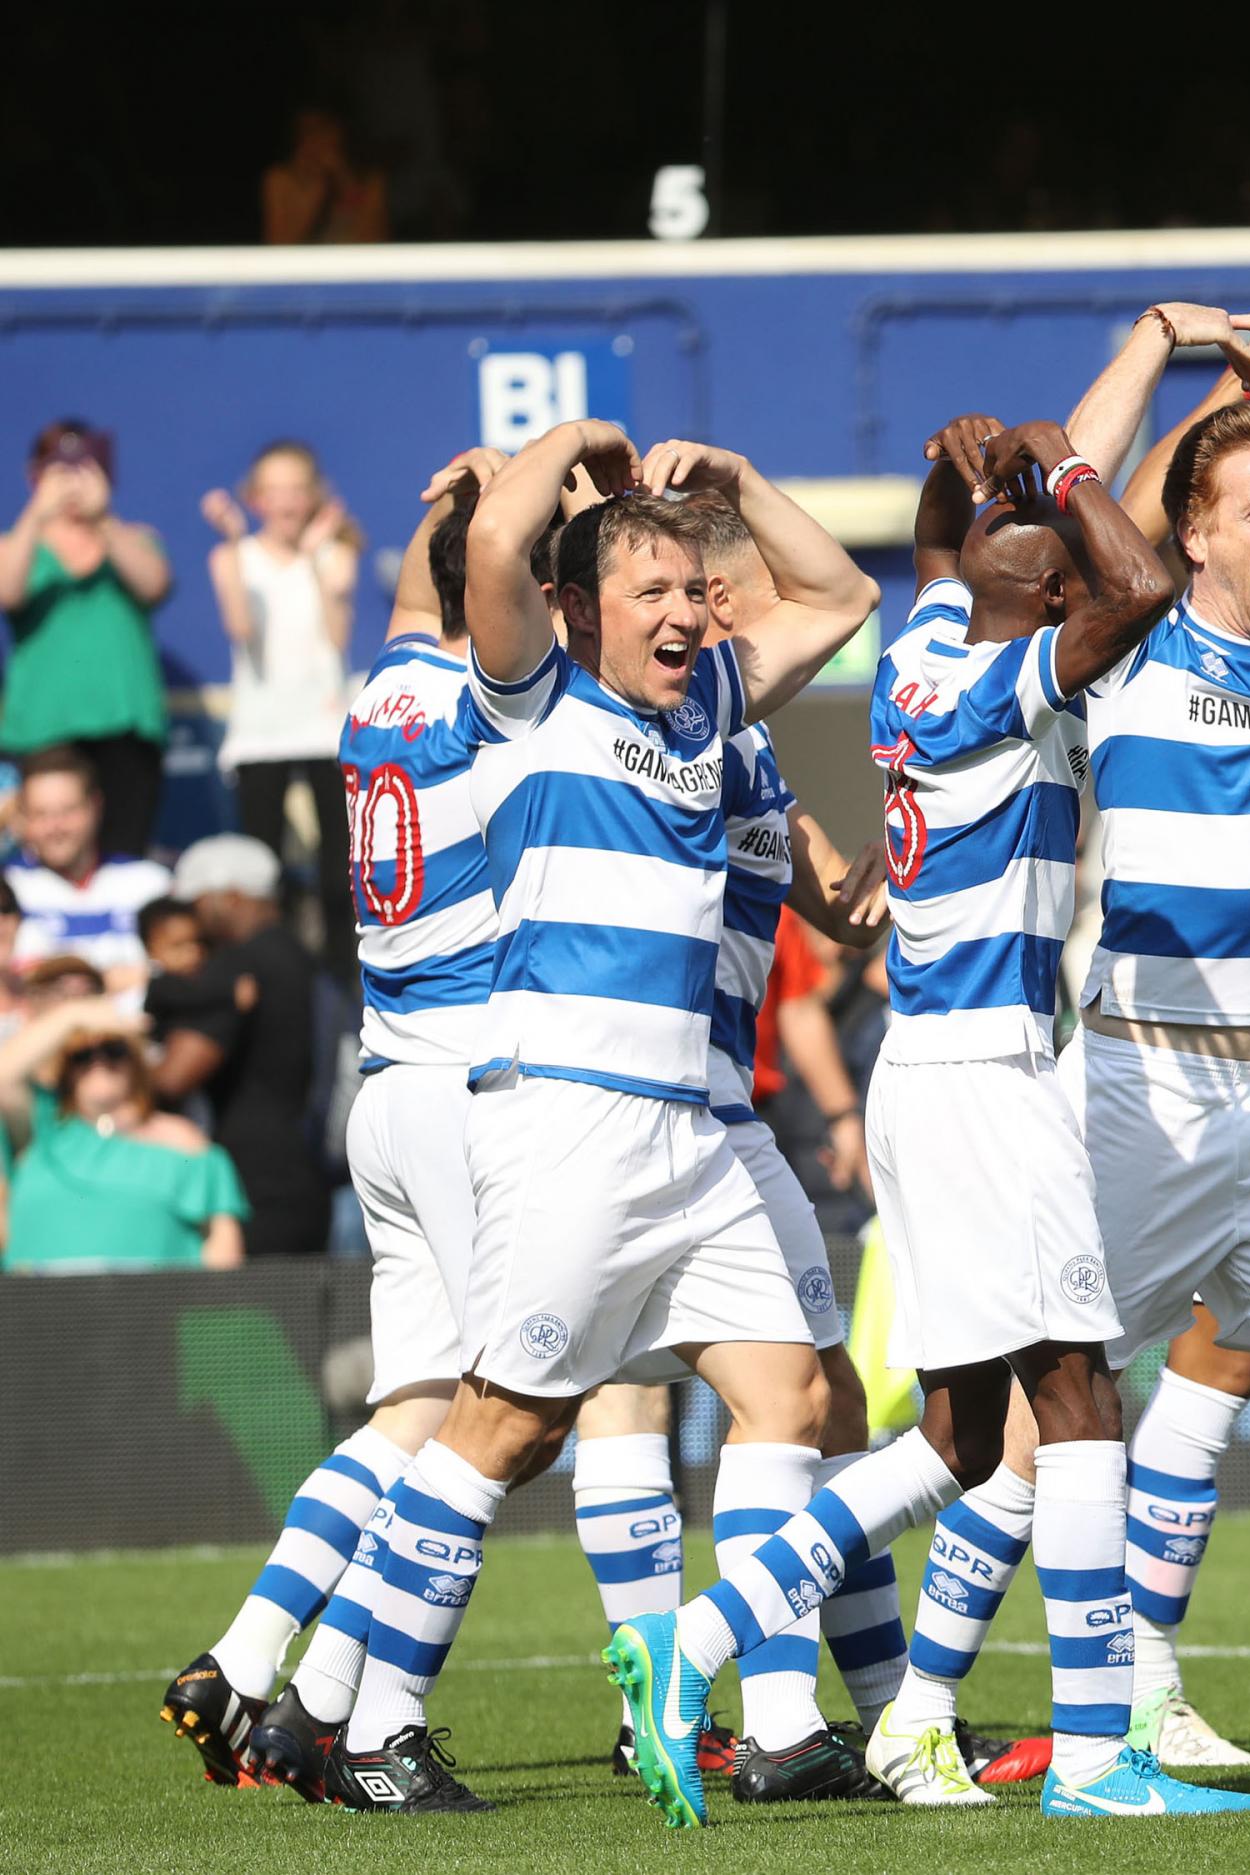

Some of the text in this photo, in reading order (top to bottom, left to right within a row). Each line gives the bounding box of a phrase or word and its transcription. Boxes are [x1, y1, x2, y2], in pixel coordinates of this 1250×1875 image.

[647, 164, 710, 241] 5
[932, 1533, 994, 1582] QPR
[928, 1584, 968, 1614] errea
